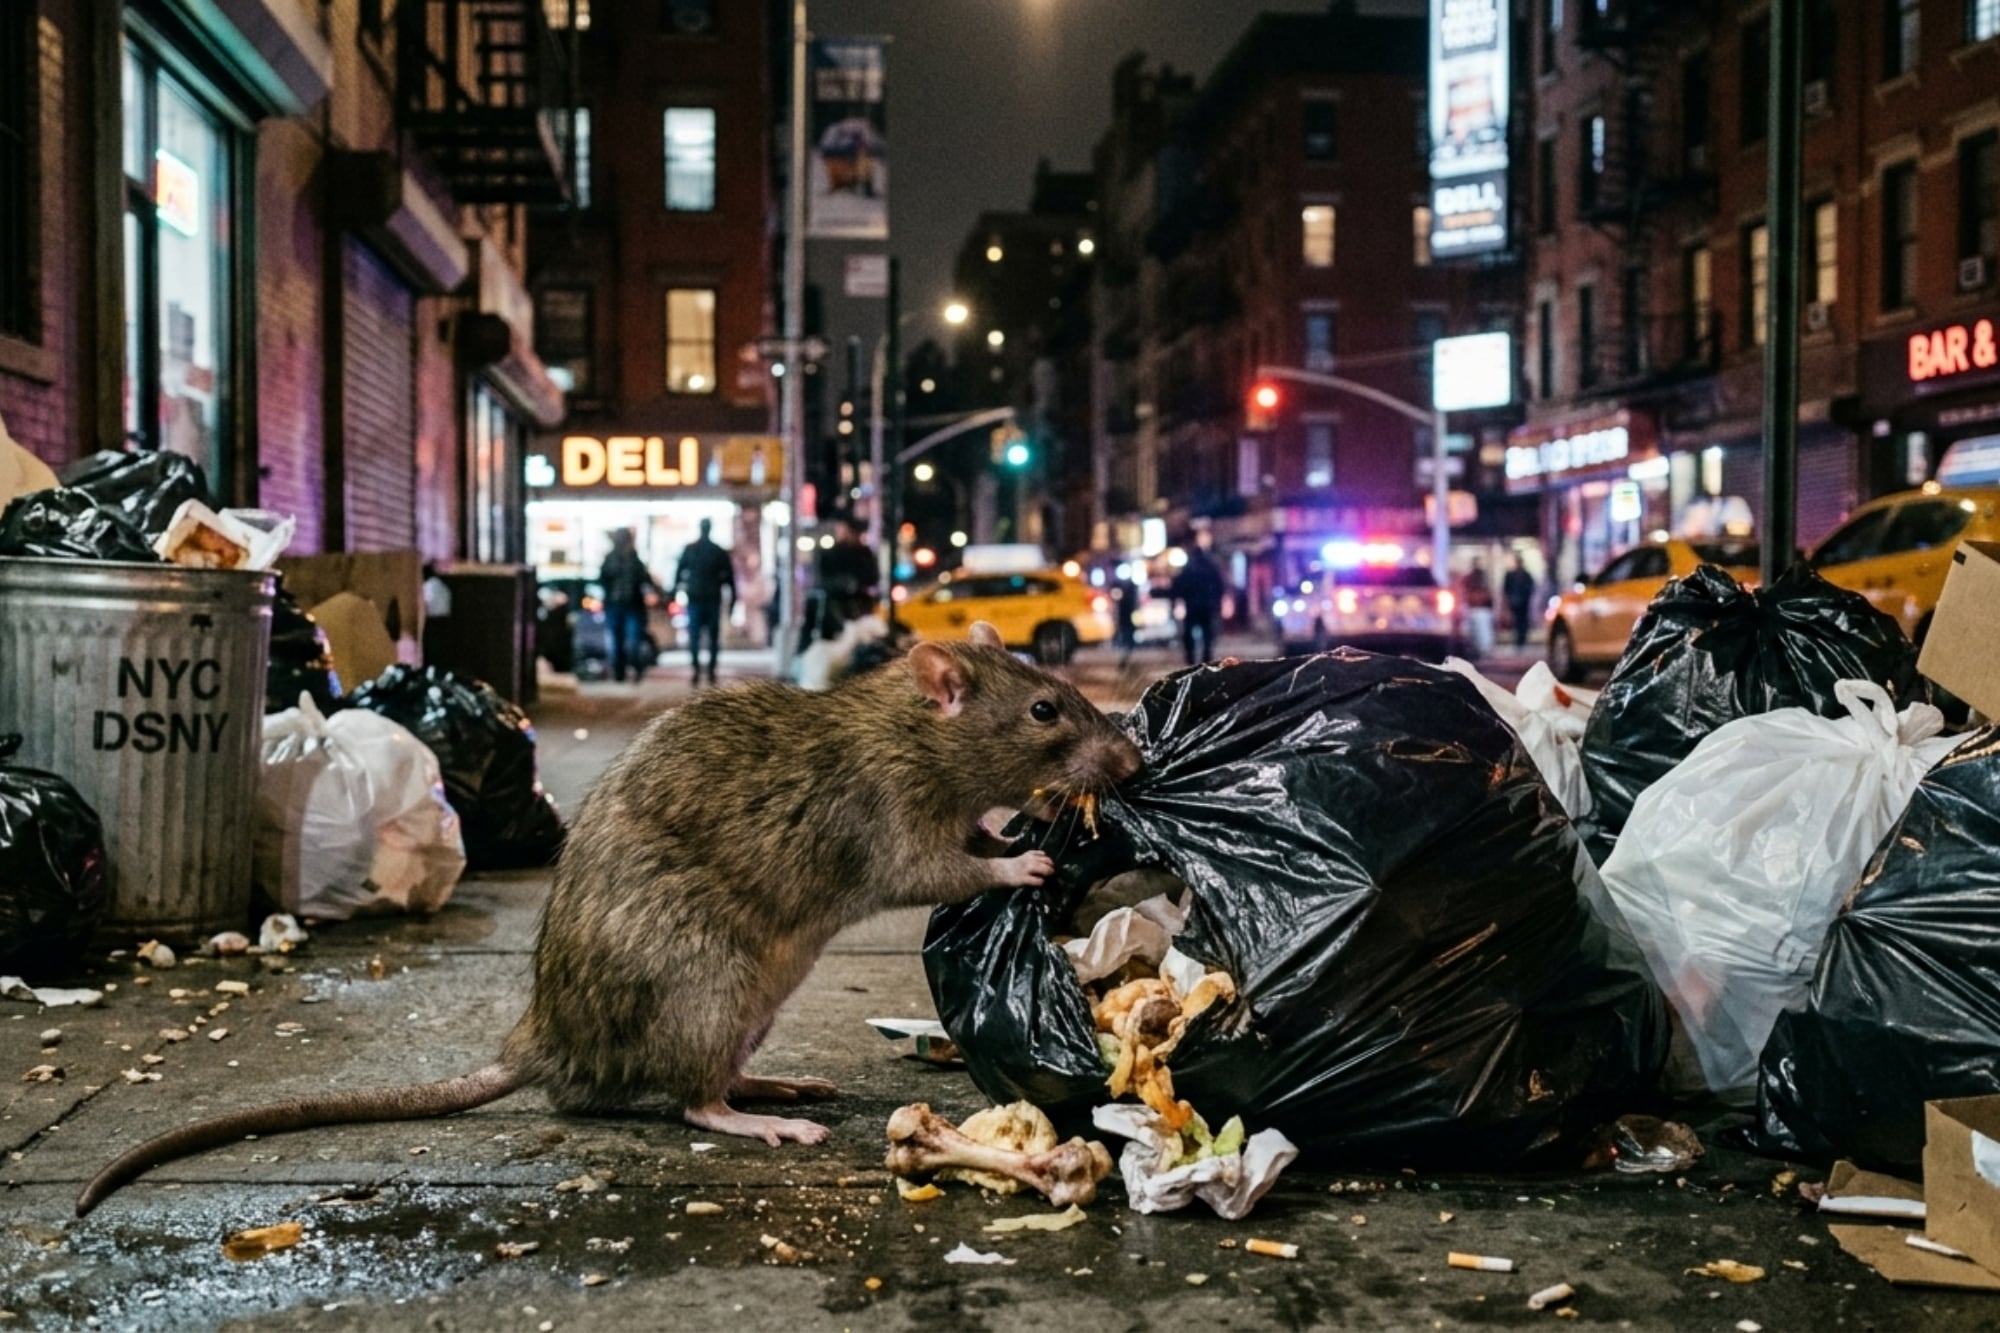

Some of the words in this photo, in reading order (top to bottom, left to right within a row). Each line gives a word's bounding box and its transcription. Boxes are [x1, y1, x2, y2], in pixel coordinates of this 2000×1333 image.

[1909, 325, 1970, 381] BAR
[1972, 319, 1997, 368] &
[562, 436, 699, 486] DELI
[117, 656, 222, 700] NYC
[93, 710, 229, 754] DSNY
